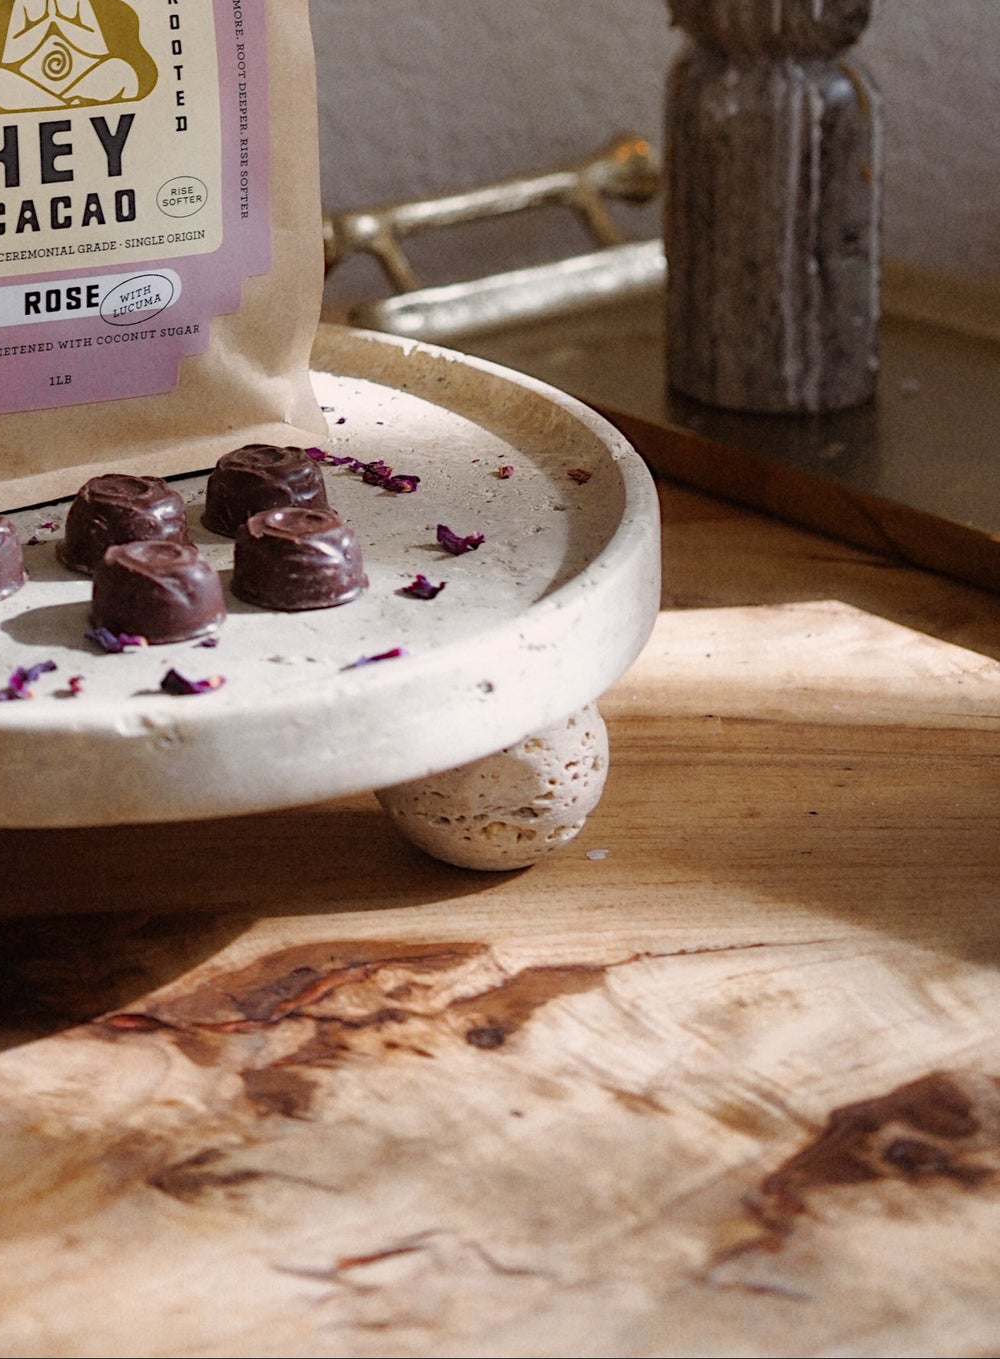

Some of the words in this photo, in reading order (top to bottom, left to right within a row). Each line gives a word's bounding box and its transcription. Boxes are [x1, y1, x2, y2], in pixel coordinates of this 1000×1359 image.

[236, 43, 247, 79] ROOT
[239, 138, 249, 168] RISE
[162, 195, 203, 207] SOFTER
[170, 186, 194, 196] RISE
[240, 170, 249, 219] SOFTER
[77, 240, 117, 254] GRADE
[124, 235, 165, 249] SINGLE
[166, 229, 206, 244] ORIGIN
[24, 284, 99, 316] ROSE
[112, 293, 162, 318] LUCUMA
[119, 285, 152, 303] WITH
[57, 337, 93, 350] WITH
[96, 329, 157, 345] COCONUT
[159, 324, 201, 337] SUGAR
